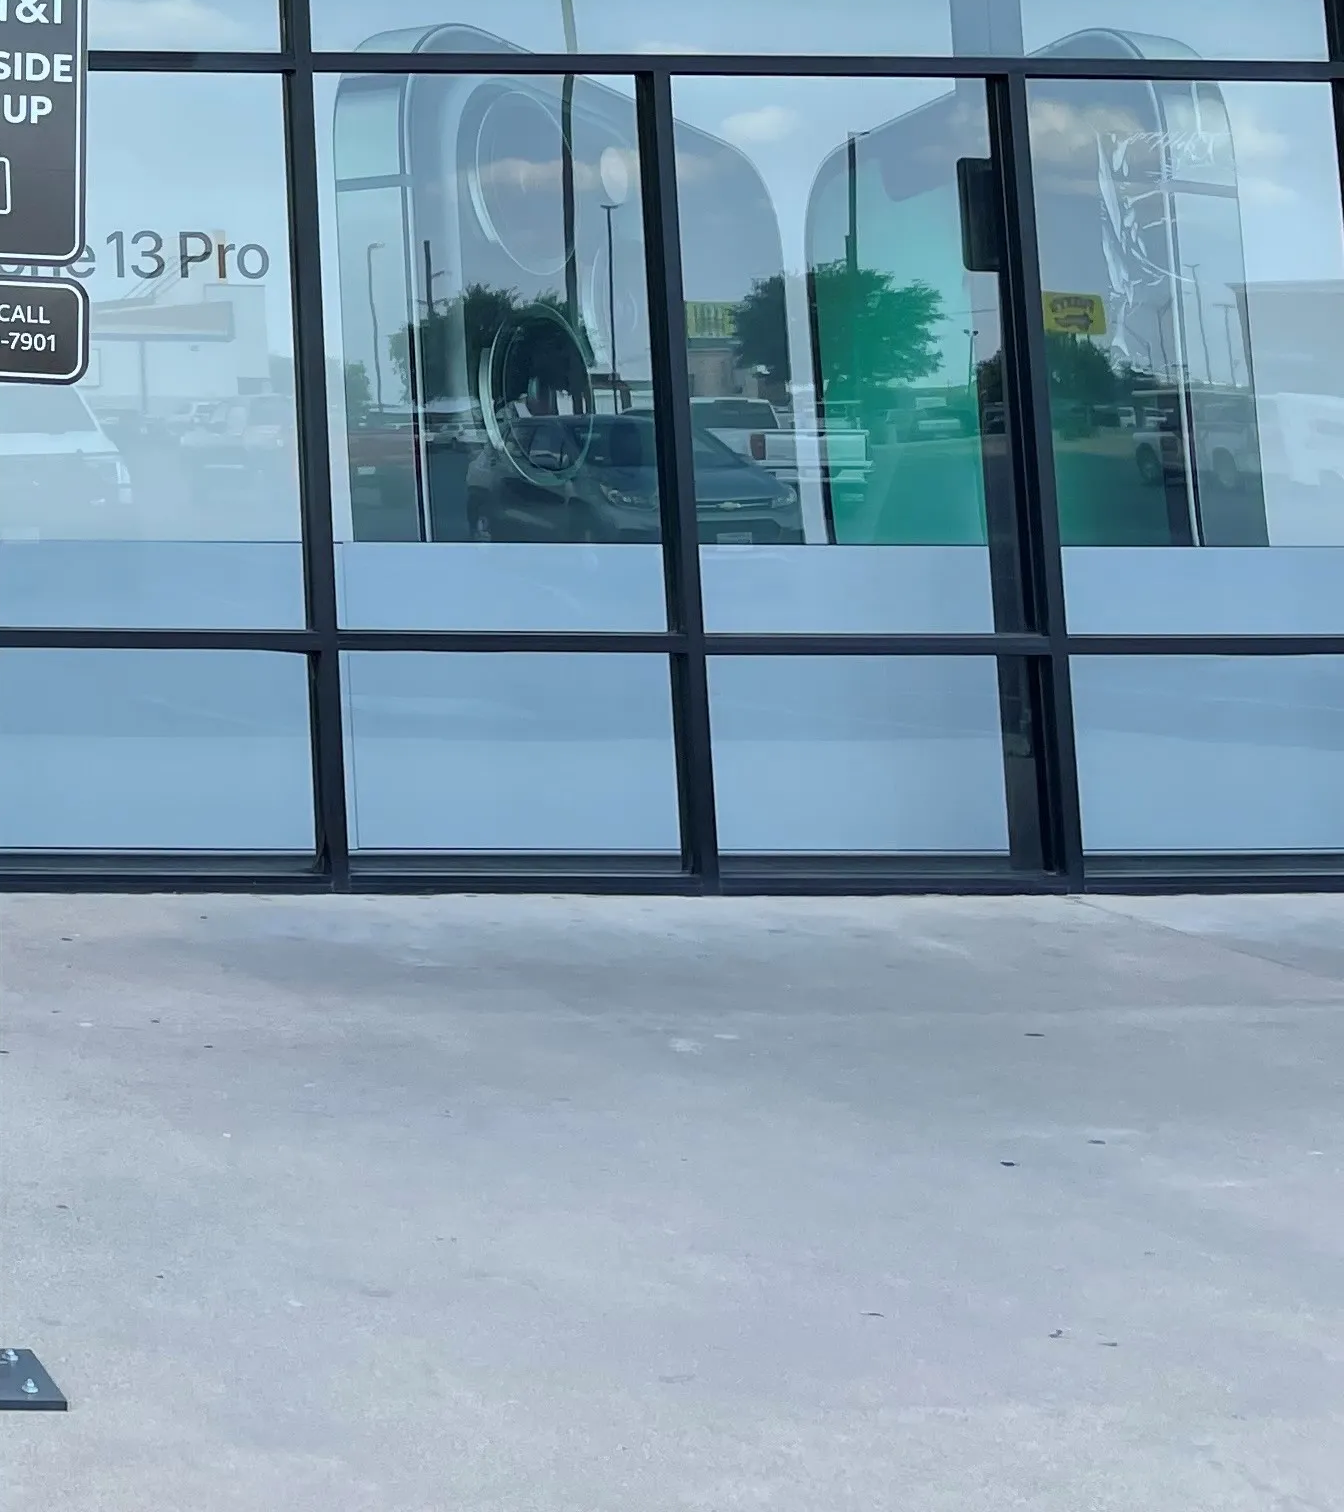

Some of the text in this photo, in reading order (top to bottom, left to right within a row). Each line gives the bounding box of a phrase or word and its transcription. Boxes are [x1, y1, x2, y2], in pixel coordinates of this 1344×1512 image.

[3, 94, 53, 124] UP
[106, 231, 166, 279] 13
[178, 231, 270, 279] Pro
